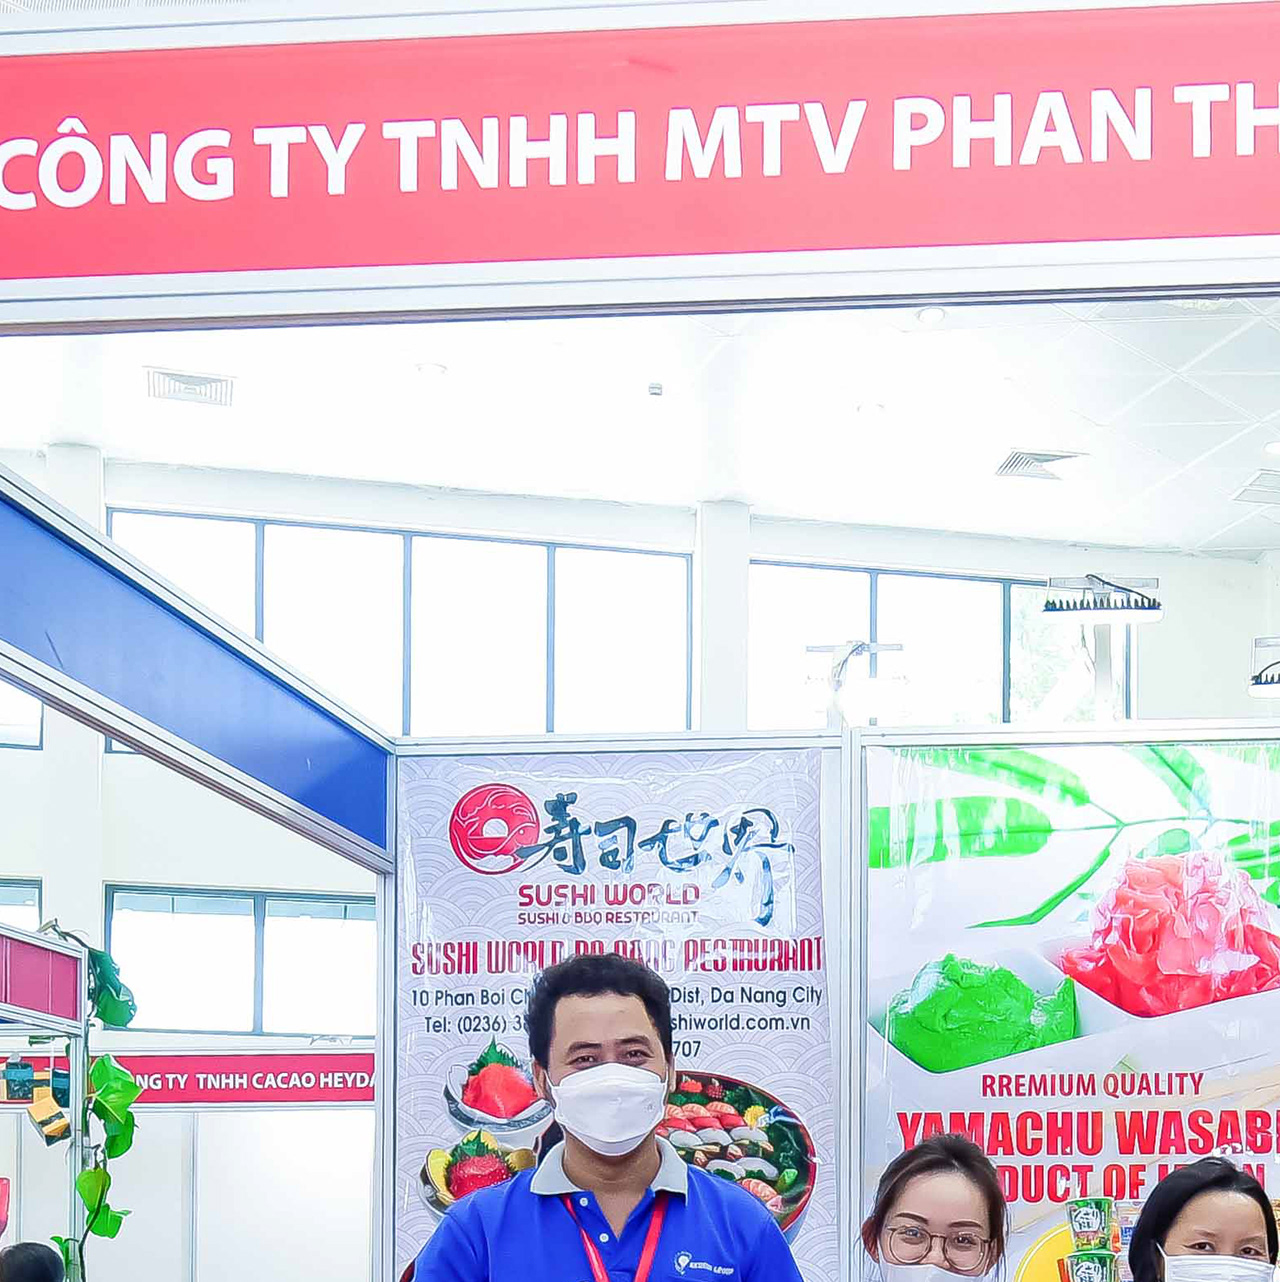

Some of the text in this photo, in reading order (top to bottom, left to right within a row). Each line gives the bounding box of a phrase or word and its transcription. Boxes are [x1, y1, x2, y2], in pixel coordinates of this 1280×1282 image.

[252, 122, 365, 198] TY
[382, 112, 636, 194] TNHH
[663, 100, 868, 183] MTV
[891, 87, 1153, 170] PHAN
[519, 883, 700, 907] SUSHI WORLD
[518, 911, 559, 925] SUSHI
[412, 937, 823, 975] SUSHI RESTAURANT
[412, 987, 823, 1008] 10 Phan Boi Da Nang City
[425, 1015, 507, 1034] Tel: (0236)
[166, 1072, 316, 1090] TY TNHH CACAO
[1103, 1072, 1205, 1099] QUALITY
